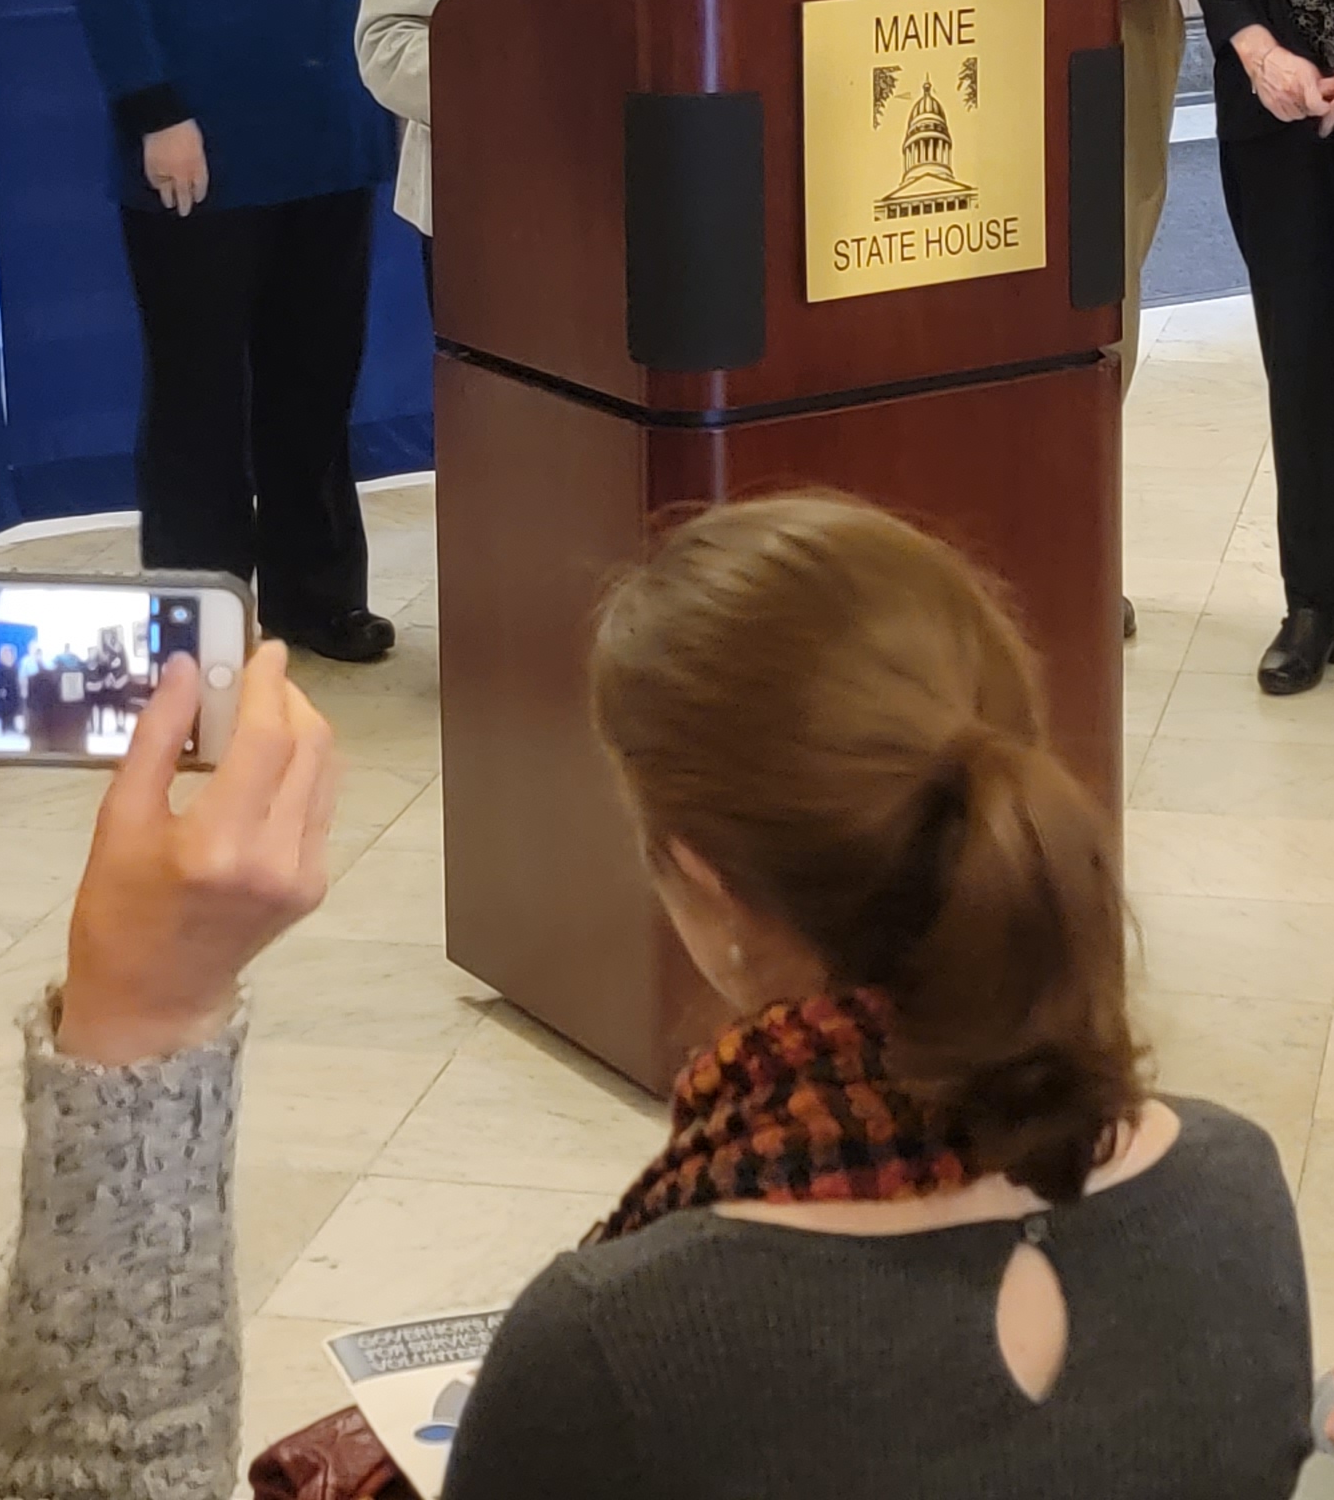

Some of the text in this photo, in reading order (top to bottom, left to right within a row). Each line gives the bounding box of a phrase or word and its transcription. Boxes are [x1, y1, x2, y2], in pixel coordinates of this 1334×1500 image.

[874, 7, 976, 54] MAINE
[833, 216, 1020, 272] STATE HOUSE
